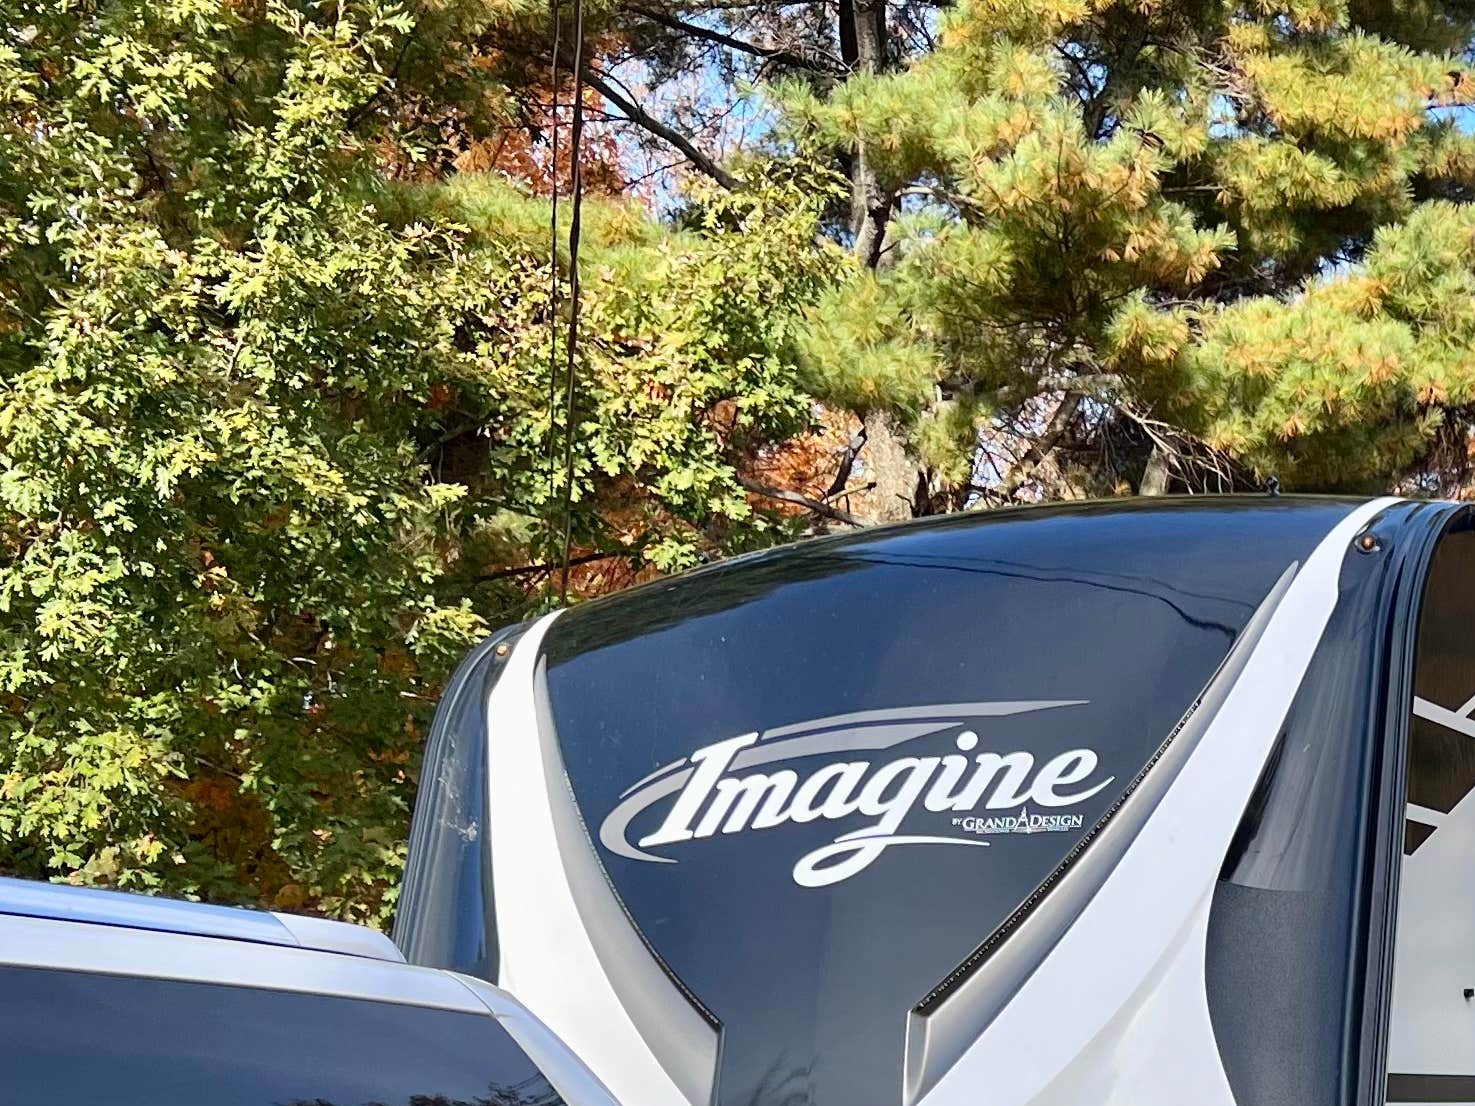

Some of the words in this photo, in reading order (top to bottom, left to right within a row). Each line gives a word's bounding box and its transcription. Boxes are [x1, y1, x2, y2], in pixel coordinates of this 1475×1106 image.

[638, 731, 1116, 888] Imagine
[962, 815, 1017, 829] GRAND
[1029, 814, 1084, 828] DESIGN
